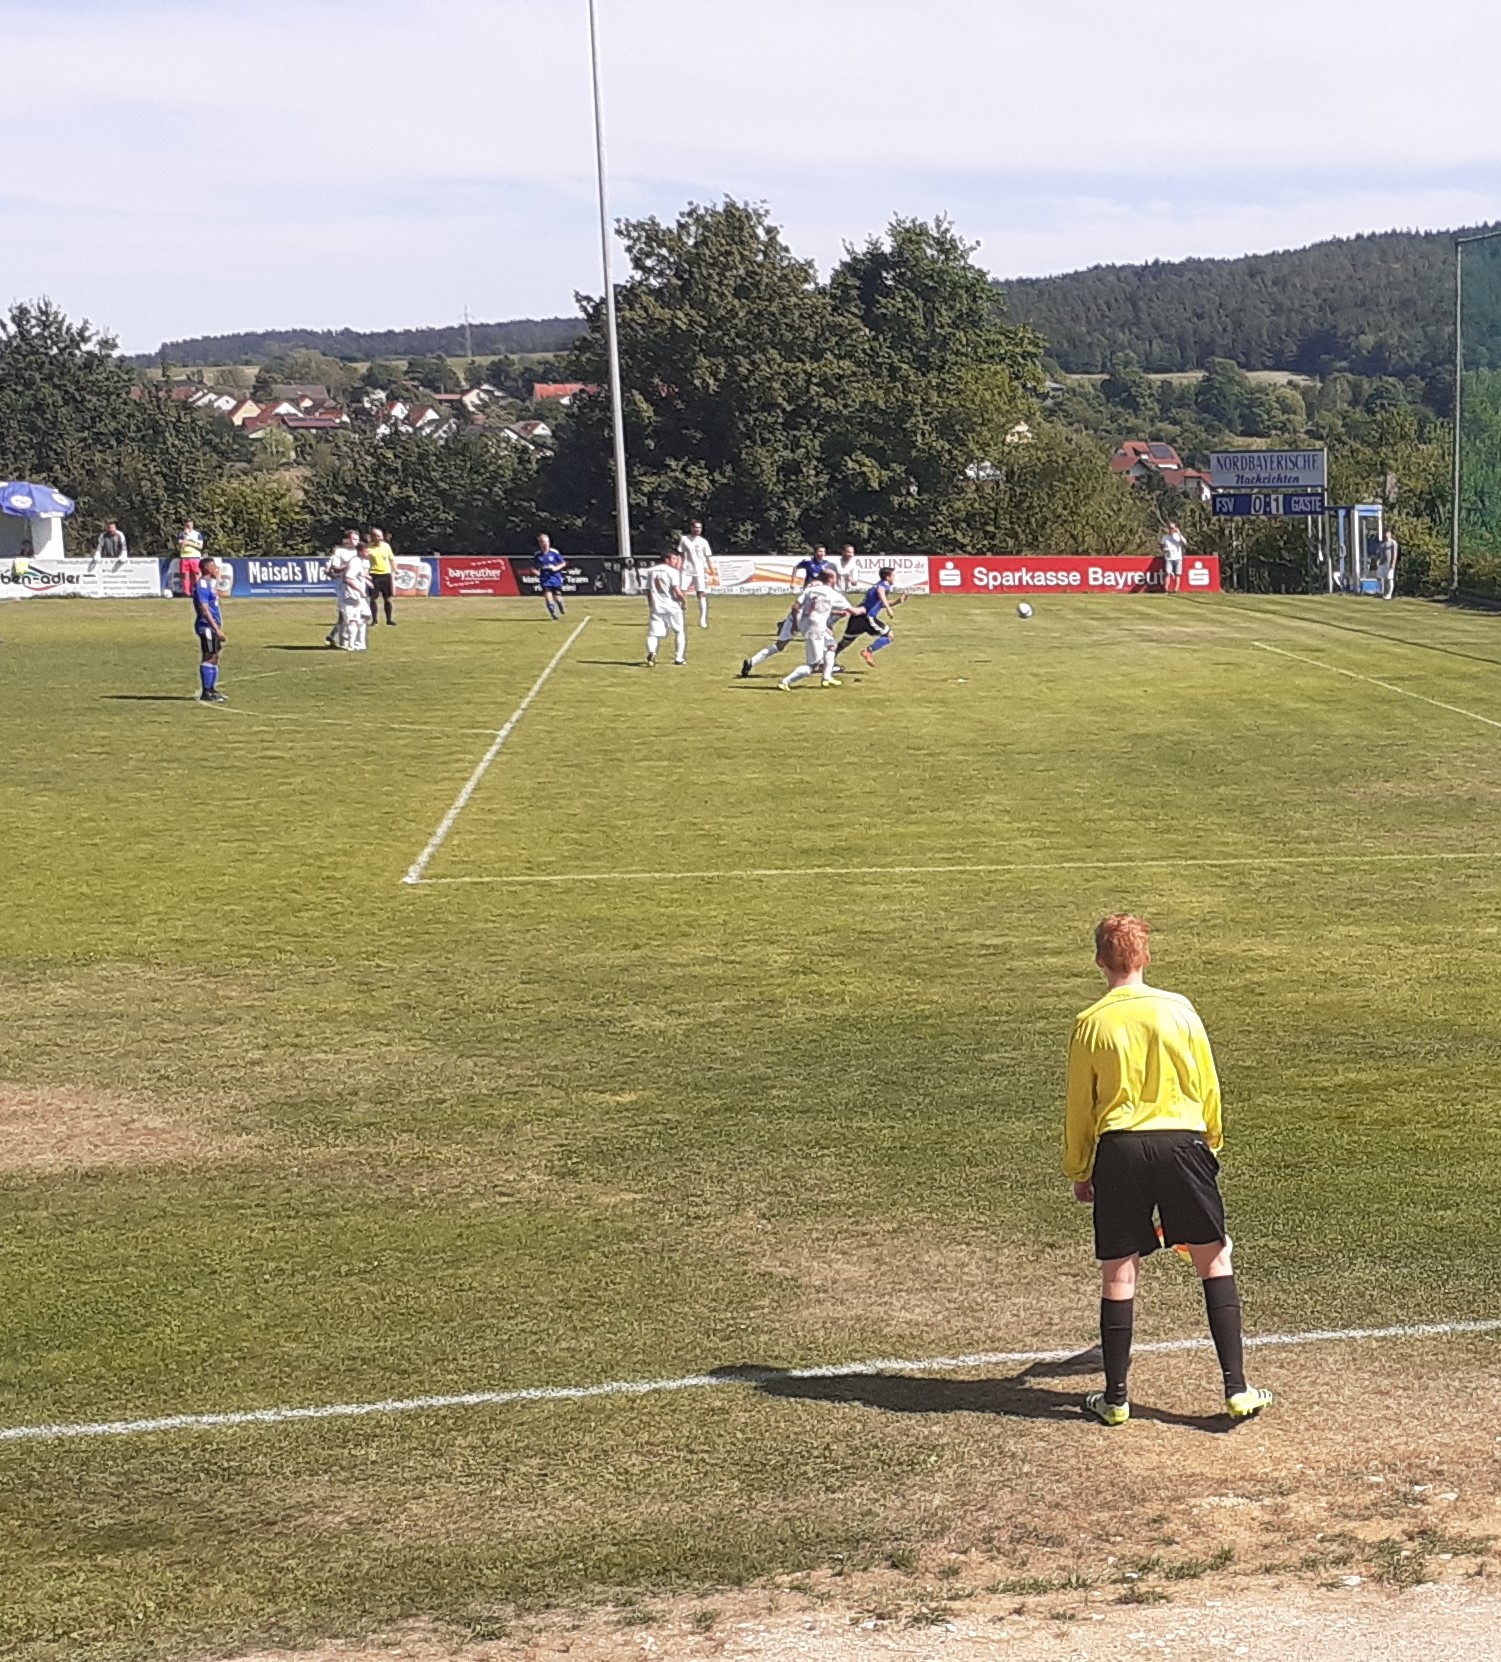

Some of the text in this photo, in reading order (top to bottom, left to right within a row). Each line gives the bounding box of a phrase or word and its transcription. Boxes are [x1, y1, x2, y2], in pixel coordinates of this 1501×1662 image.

[1216, 454, 1319, 471] NORDBAYERISCHE
[1235, 473, 1300, 485] Nachrichten
[1215, 497, 1235, 512] FSV
[248, 561, 302, 583] Maisel's
[447, 567, 502, 580] bayreuther
[973, 567, 1080, 589] Sparkasse
[1088, 567, 1166, 589] Bayreut
